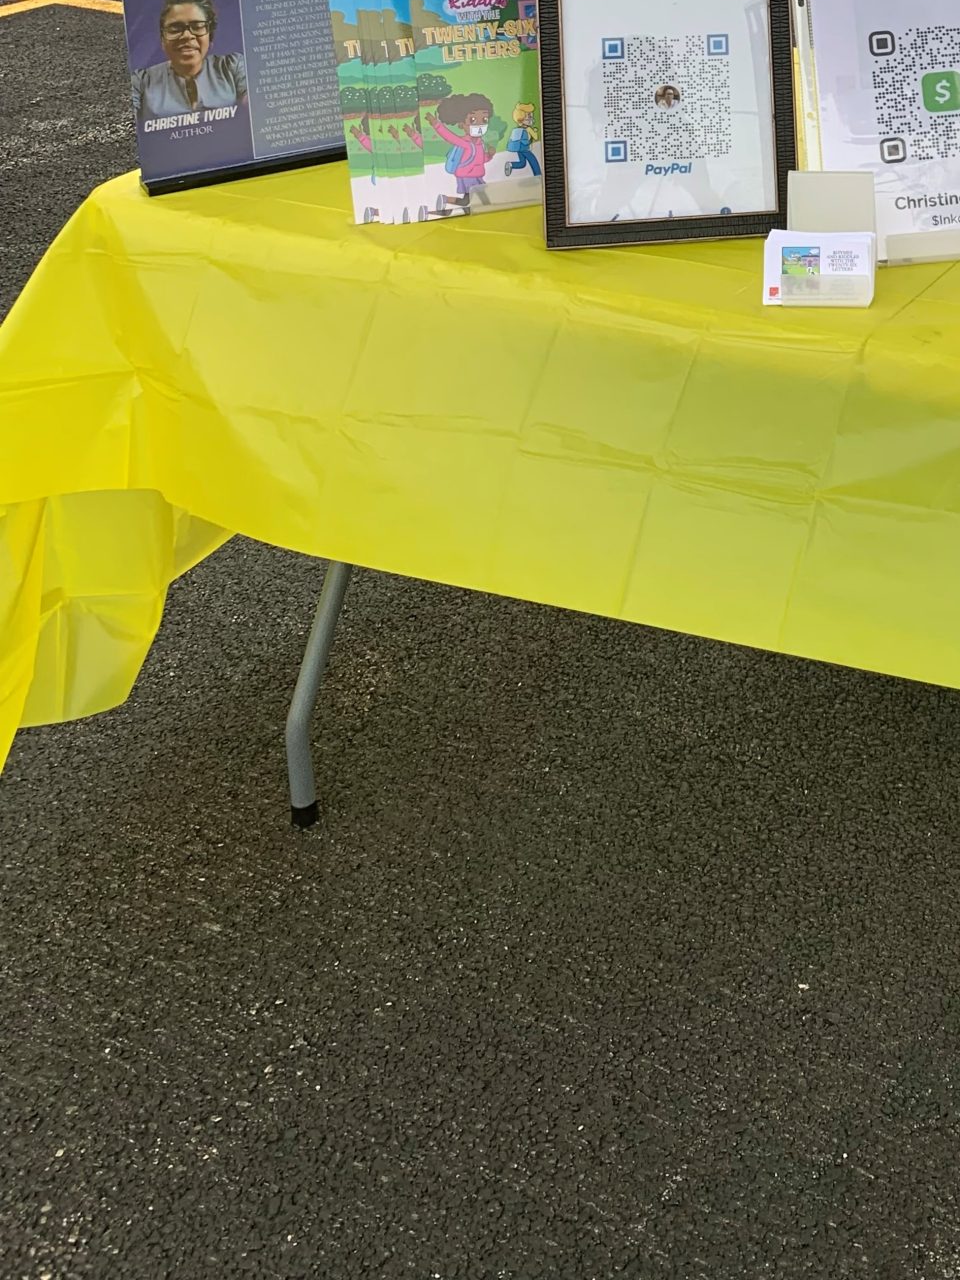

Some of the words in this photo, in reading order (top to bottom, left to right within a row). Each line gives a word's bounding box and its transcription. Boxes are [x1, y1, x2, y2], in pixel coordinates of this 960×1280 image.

[456, 10, 481, 23] WITH
[482, 8, 501, 21] THE
[422, 18, 536, 45] TWENTY-SIX
[442, 39, 520, 63] LETTERS
[144, 111, 201, 133] CHRISTINE
[203, 105, 238, 123] IVORY
[169, 125, 214, 140] AUTHOR
[645, 162, 692, 176] PayPal
